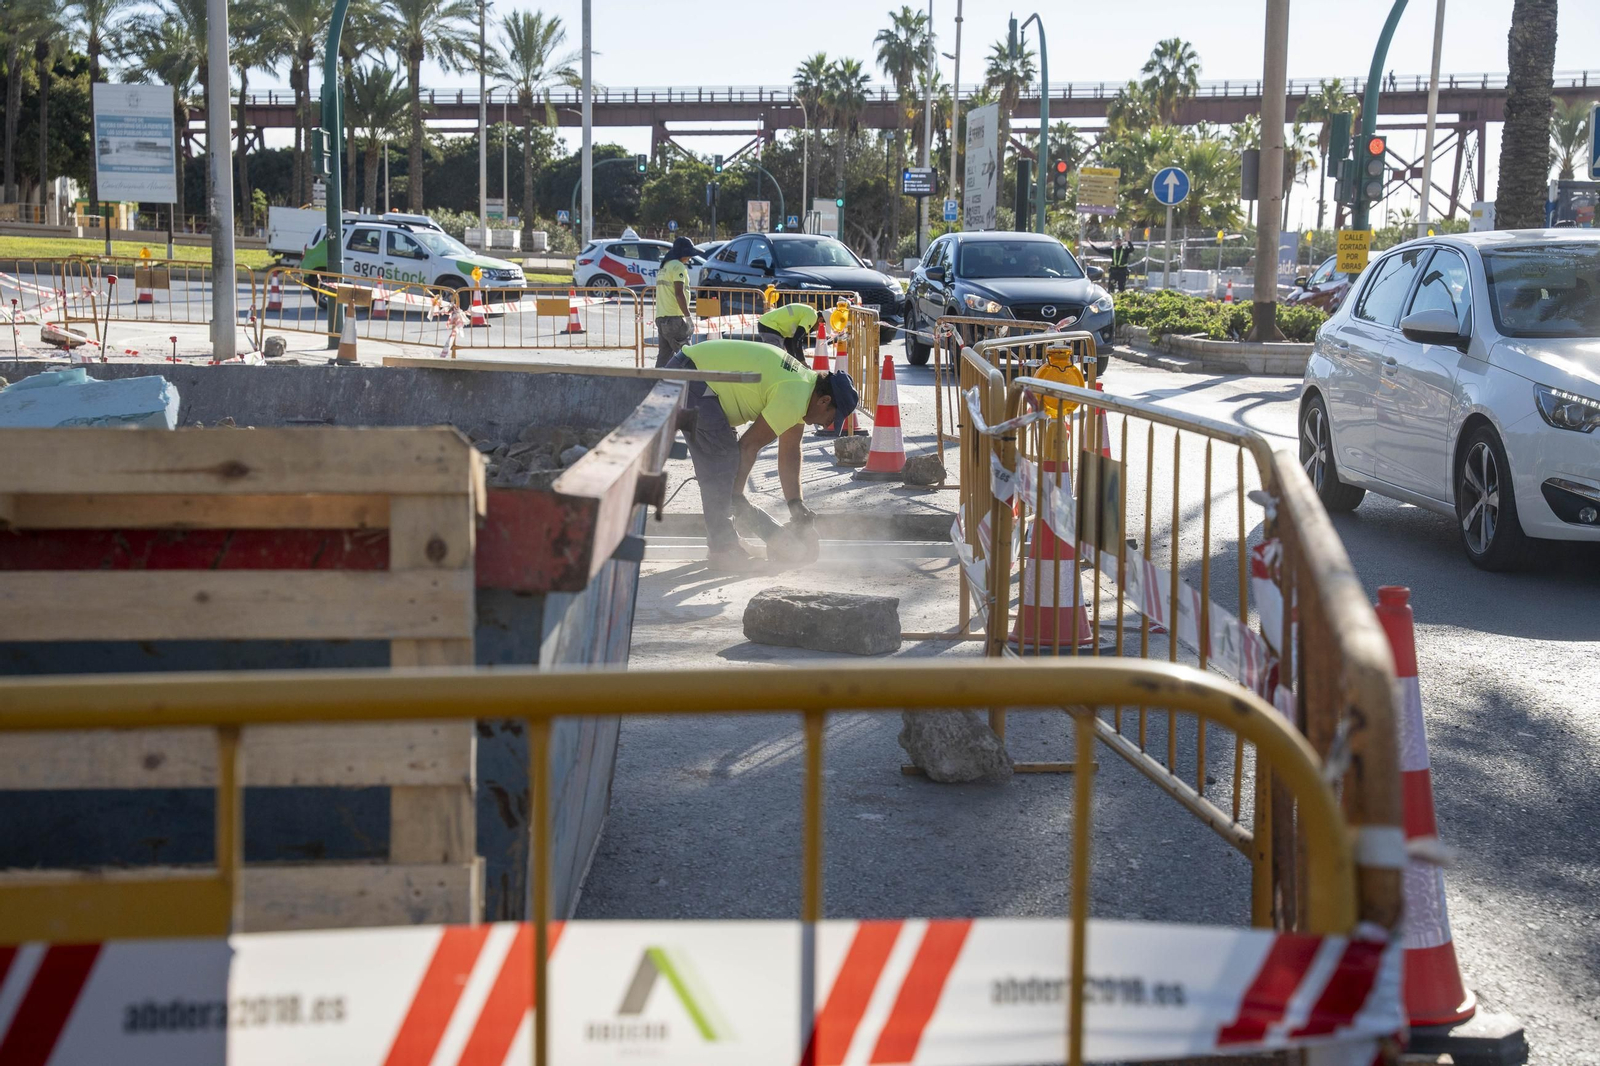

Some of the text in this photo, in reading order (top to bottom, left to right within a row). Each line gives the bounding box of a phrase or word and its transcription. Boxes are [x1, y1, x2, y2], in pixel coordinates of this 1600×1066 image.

[948, 202, 955, 211] P
[1344, 233, 1364, 241] CALLE
[1339, 243, 1367, 251] CORTADA
[1341, 262, 1362, 270] OBRAS
[353, 261, 426, 284] agrostock
